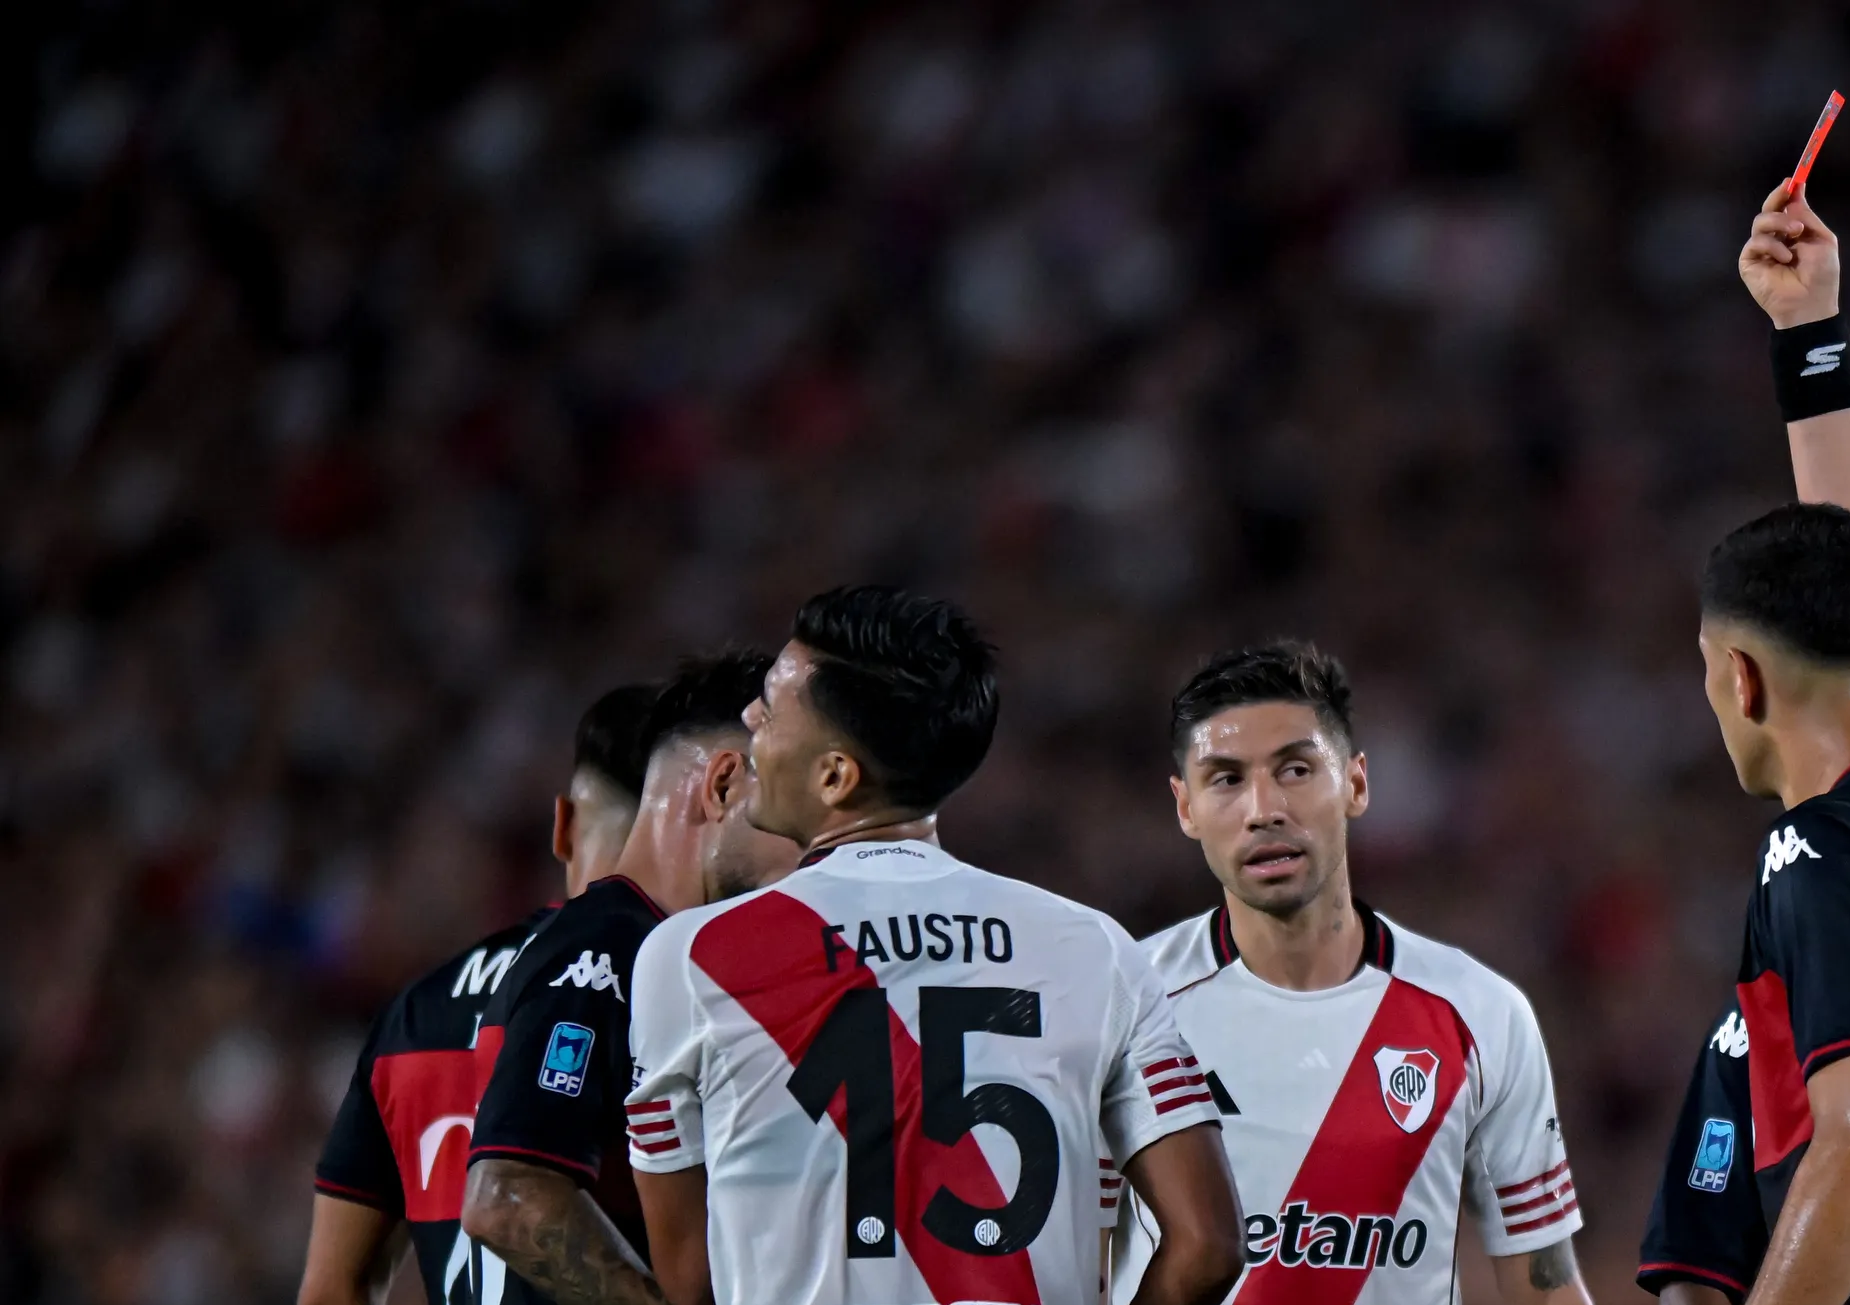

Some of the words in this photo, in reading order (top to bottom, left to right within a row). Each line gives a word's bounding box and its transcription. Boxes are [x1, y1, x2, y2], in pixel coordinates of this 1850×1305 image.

[821, 914, 1013, 973] FAUSTO
[542, 1068, 579, 1092] LPF
[786, 985, 1060, 1259] 15
[1693, 1168, 1727, 1191] LPF
[1243, 1201, 1428, 1271] etano
